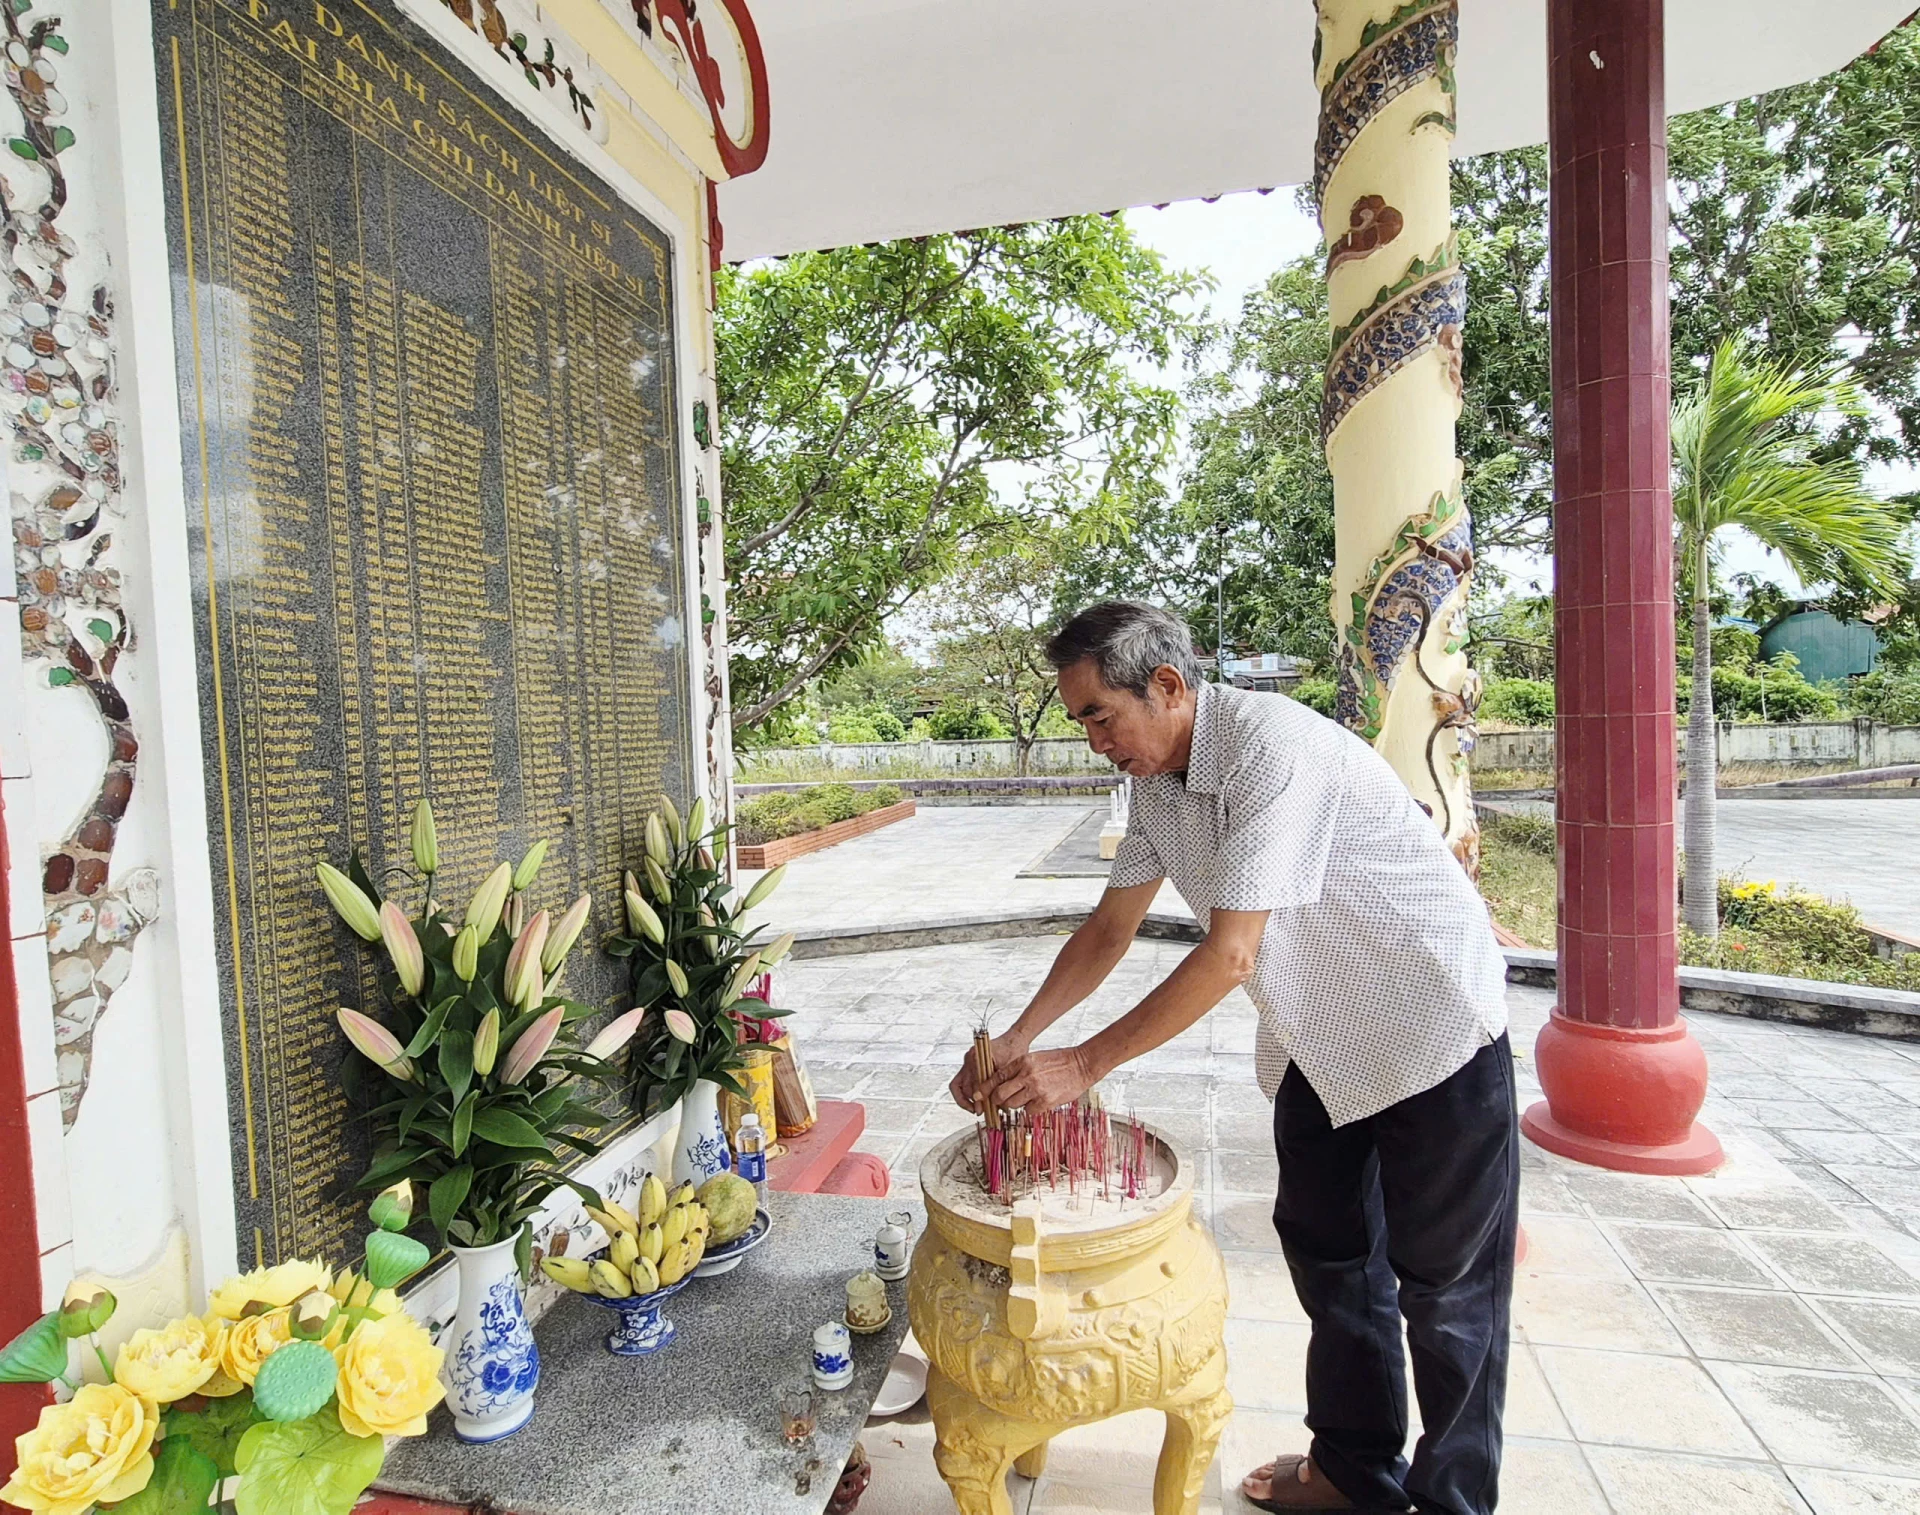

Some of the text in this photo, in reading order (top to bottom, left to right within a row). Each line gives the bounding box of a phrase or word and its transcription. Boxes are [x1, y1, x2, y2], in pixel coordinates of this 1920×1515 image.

[315, 1, 427, 104] DANH
[438, 99, 520, 175] SÁCH
[528, 170, 585, 222] LIỆT
[336, 59, 403, 125] BIA
[413, 119, 475, 176] GHI
[485, 171, 562, 238] DANH
[570, 233, 620, 279] LIỆT
